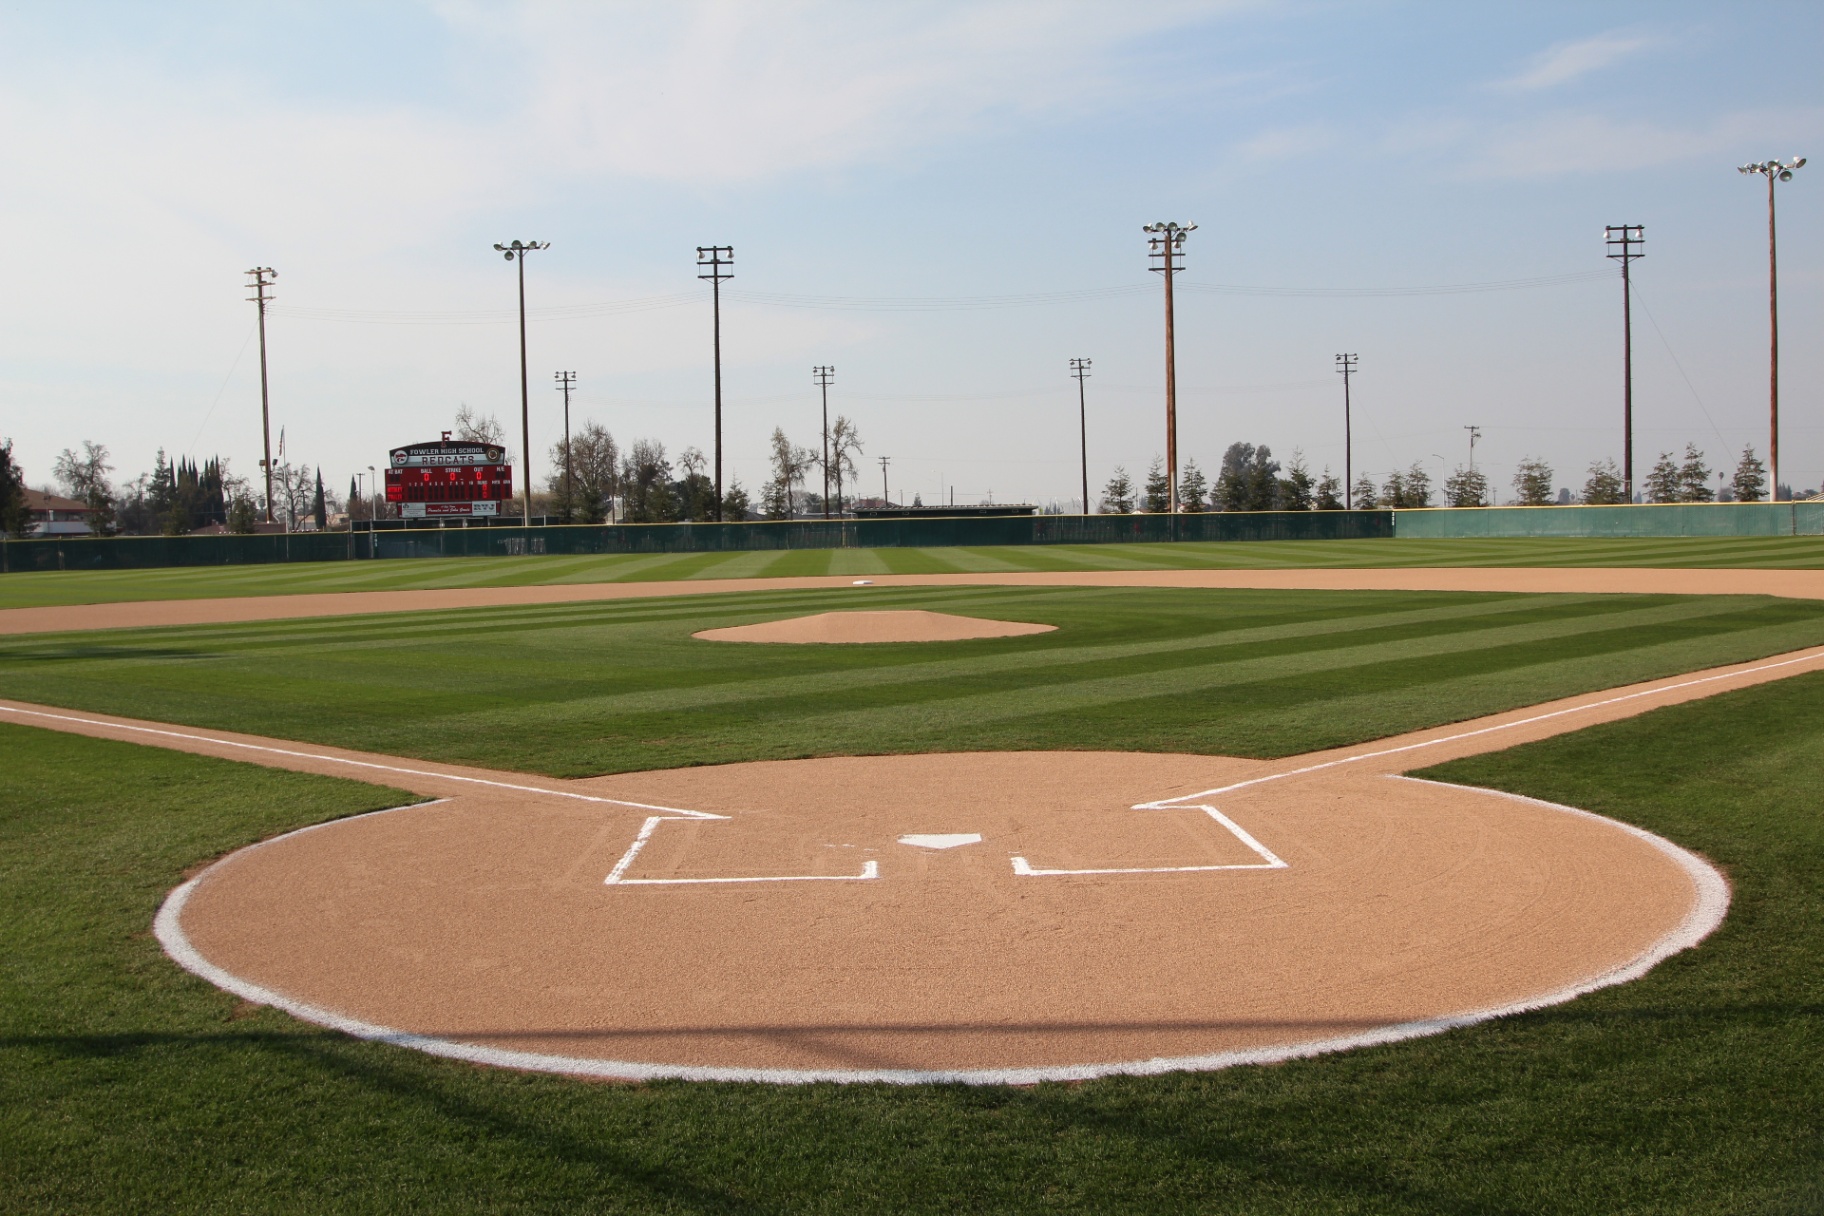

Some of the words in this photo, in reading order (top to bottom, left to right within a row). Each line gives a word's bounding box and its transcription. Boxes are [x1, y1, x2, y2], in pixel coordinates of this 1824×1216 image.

[441, 430, 452, 448] F
[422, 456, 474, 466] REDCATS
[424, 473, 430, 482] 0
[450, 472, 456, 480] 0
[476, 472, 482, 480] 0
